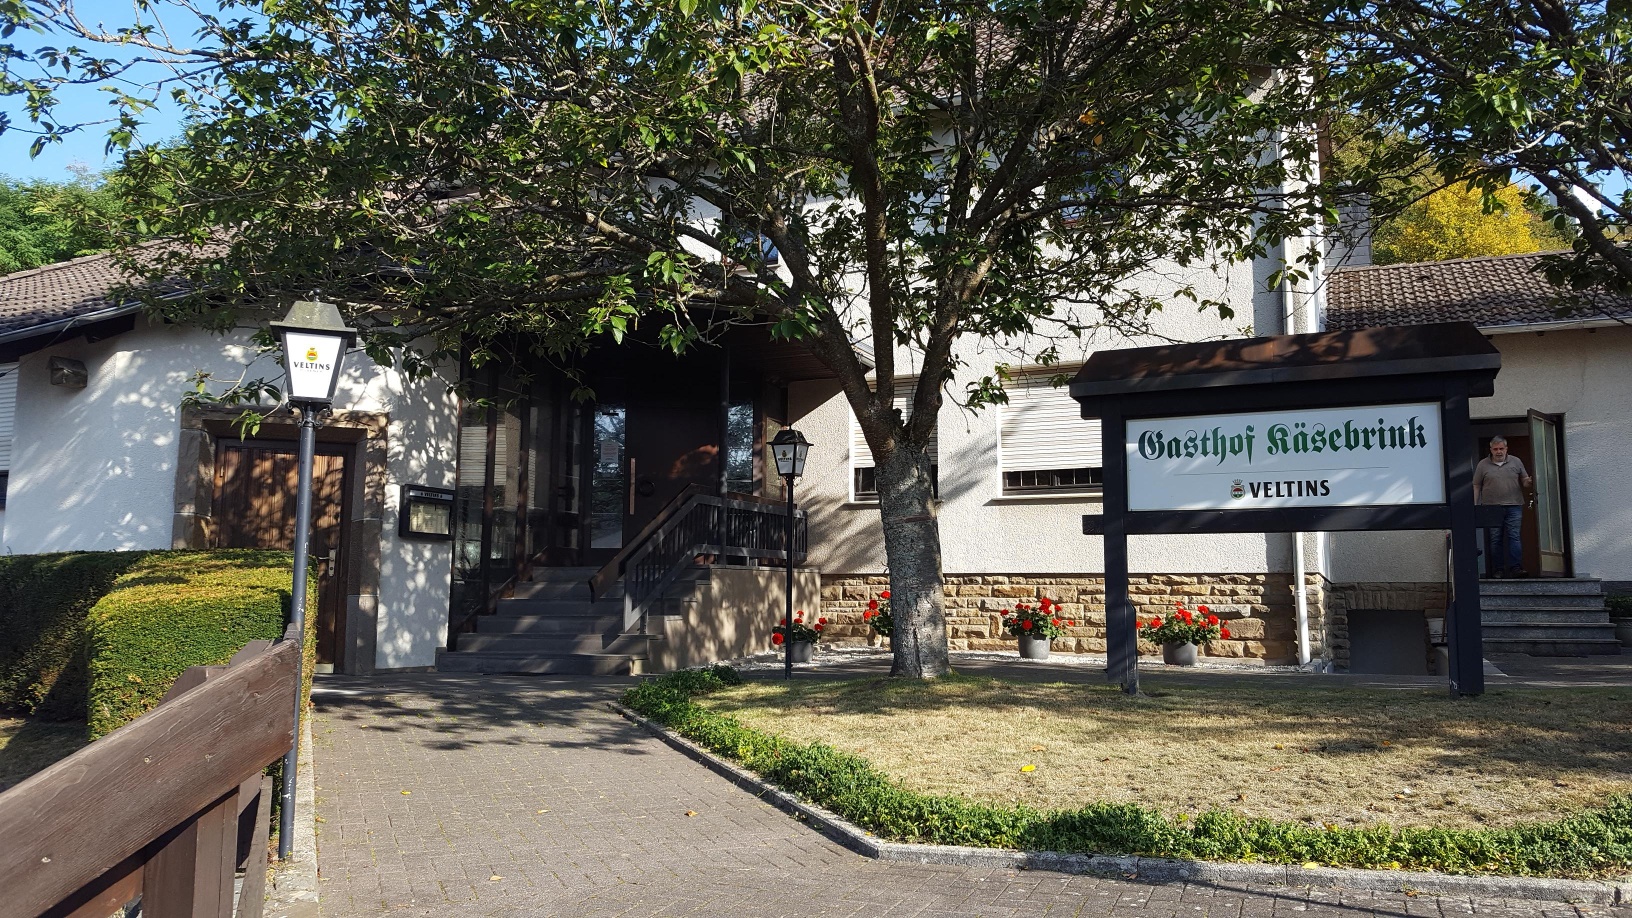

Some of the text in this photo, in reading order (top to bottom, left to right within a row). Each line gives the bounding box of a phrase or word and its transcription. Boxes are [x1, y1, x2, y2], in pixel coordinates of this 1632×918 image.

[293, 361, 331, 370] VELTINS
[1137, 416, 1428, 466] Gasthof Käsebrink
[1249, 479, 1331, 499] VELTINS
